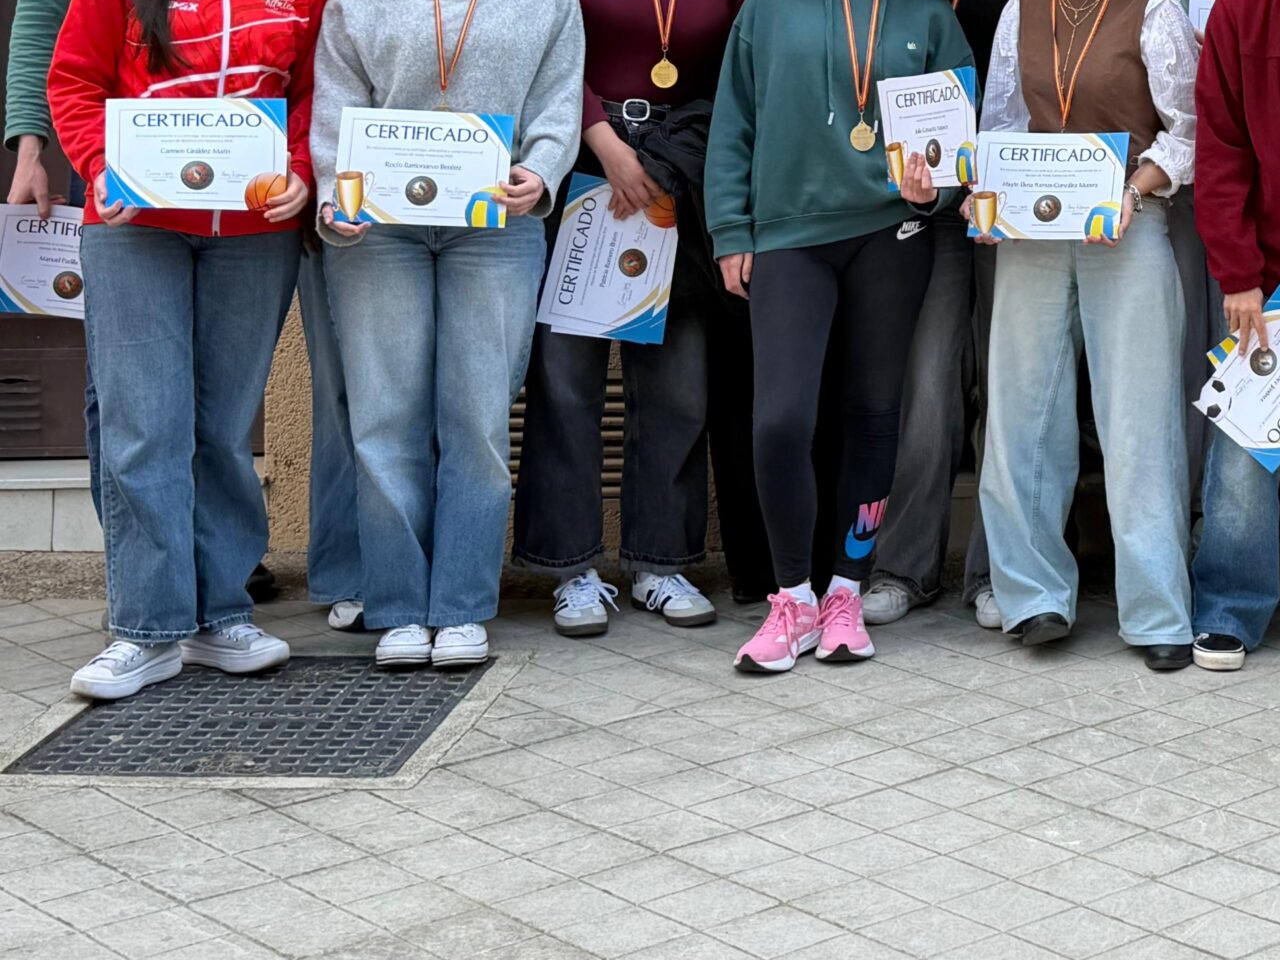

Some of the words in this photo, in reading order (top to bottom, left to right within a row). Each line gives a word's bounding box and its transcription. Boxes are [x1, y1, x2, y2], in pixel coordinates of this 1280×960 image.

[896, 84, 960, 109] CERTIFICADO
[132, 113, 262, 127] CERTIFICADO
[365, 124, 489, 143] CERTIFICADO
[999, 147, 1107, 162] CERTIFICADO
[902, 220, 921, 232] NIKE
[558, 197, 596, 305] CERTIFICADO
[856, 496, 889, 534] NI
